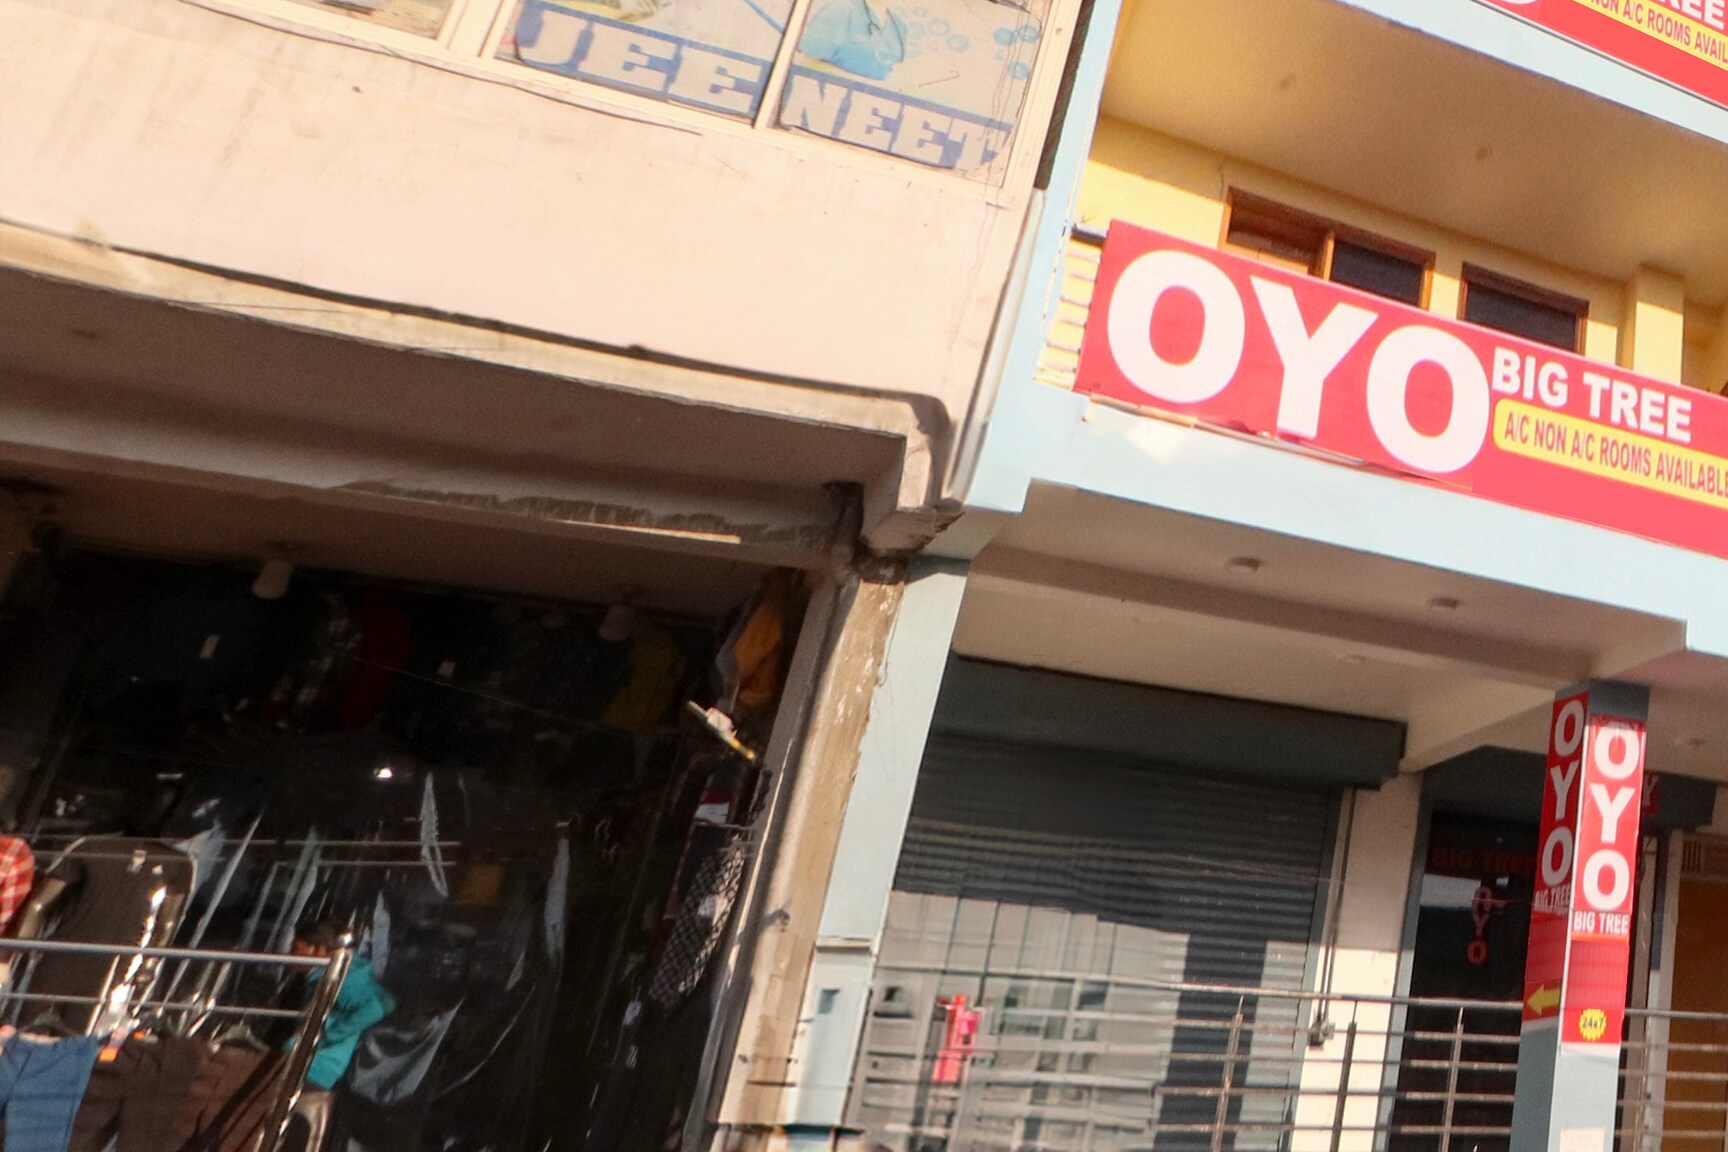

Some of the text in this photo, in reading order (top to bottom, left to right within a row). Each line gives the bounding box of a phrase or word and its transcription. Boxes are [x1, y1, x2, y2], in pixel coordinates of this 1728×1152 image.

[516, 8, 763, 118] JEE
[1623, 0, 1644, 25] A/C
[1646, 9, 1693, 51] ROOMS
[779, 74, 1012, 169] NEET
[1108, 250, 1490, 474] OYO
[1492, 347, 1692, 443] BIG TREE
[1504, 413, 1530, 446] A/C
[1533, 421, 1568, 456] NON
[1571, 430, 1597, 461] A/C
[1599, 437, 1652, 475] ROOMS
[1541, 699, 1584, 887] OYO
[1582, 720, 1641, 913] OYO
[1573, 911, 1630, 935] BIG TREE
[1582, 1016, 1606, 1031] 24x7
